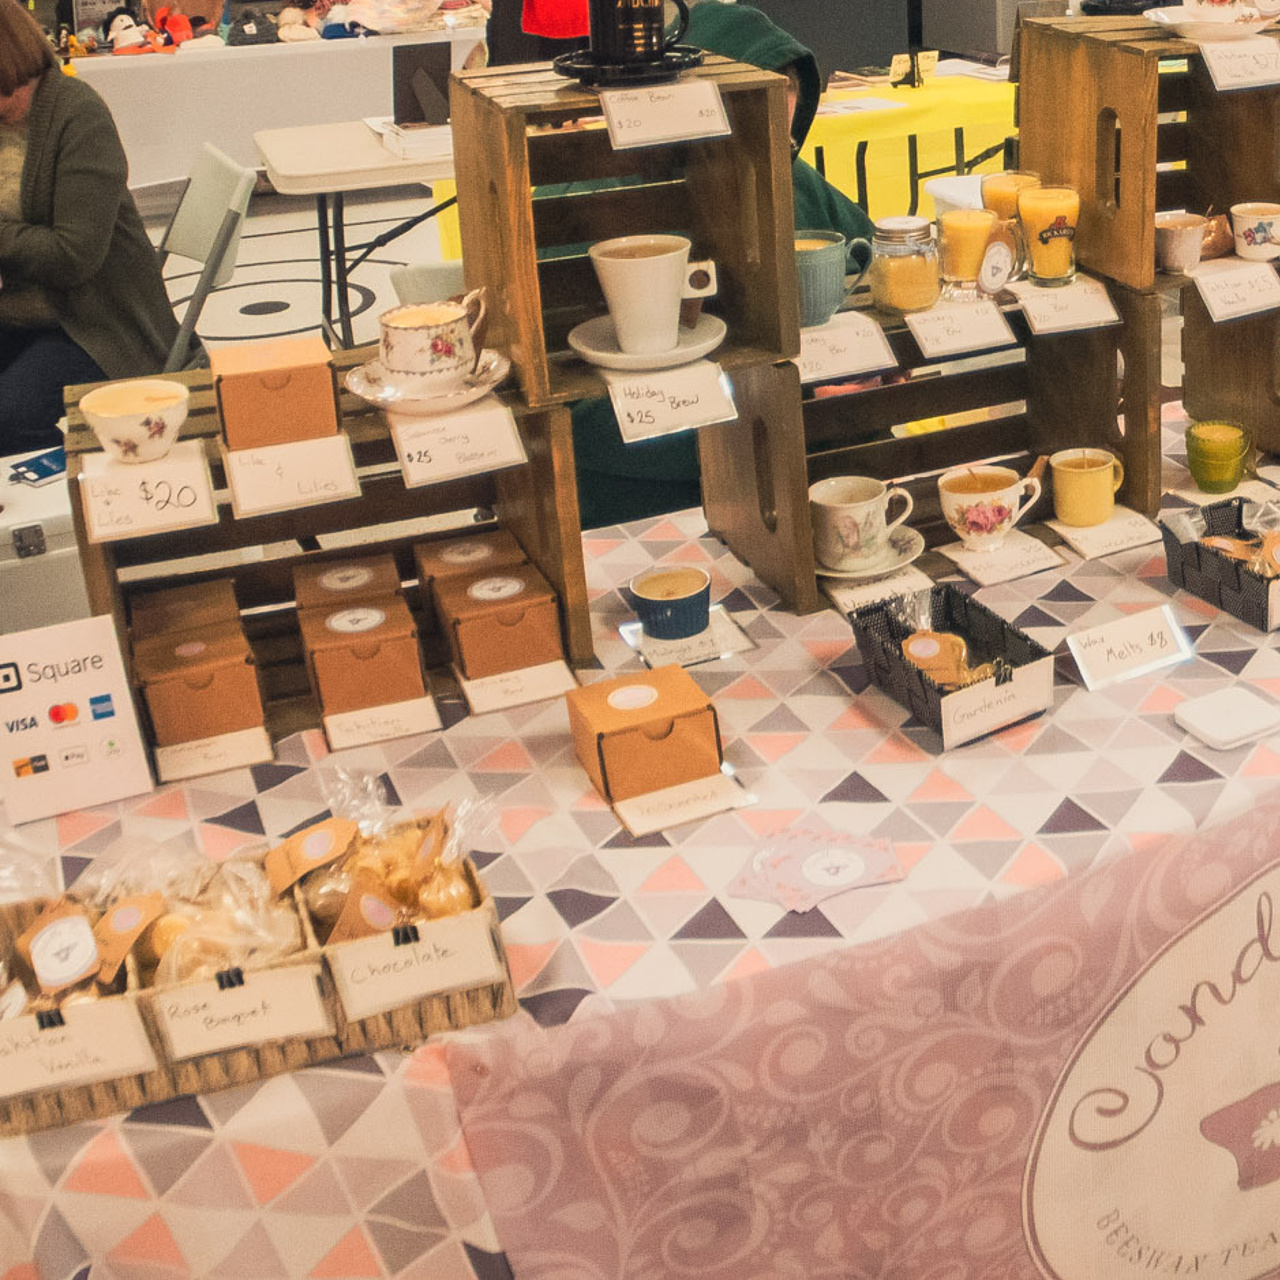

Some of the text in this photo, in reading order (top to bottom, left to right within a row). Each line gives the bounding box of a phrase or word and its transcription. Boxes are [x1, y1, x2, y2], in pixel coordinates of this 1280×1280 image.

[616, 119, 642, 129] $20
[623, 387, 700, 410] Holiday Brew
[627, 410, 656, 425] $25
[406, 450, 433, 464] $25
[138, 479, 198, 511] $20
[1106, 629, 1168, 663] Melts $8
[27, 654, 104, 683] Square
[952, 690, 1016, 725] Gardenia
[5, 716, 39, 733] VISA
[350, 944, 457, 987] Chocolate
[166, 1001, 210, 1019] Rose
[1094, 1206, 1208, 1274] BEESWAX
